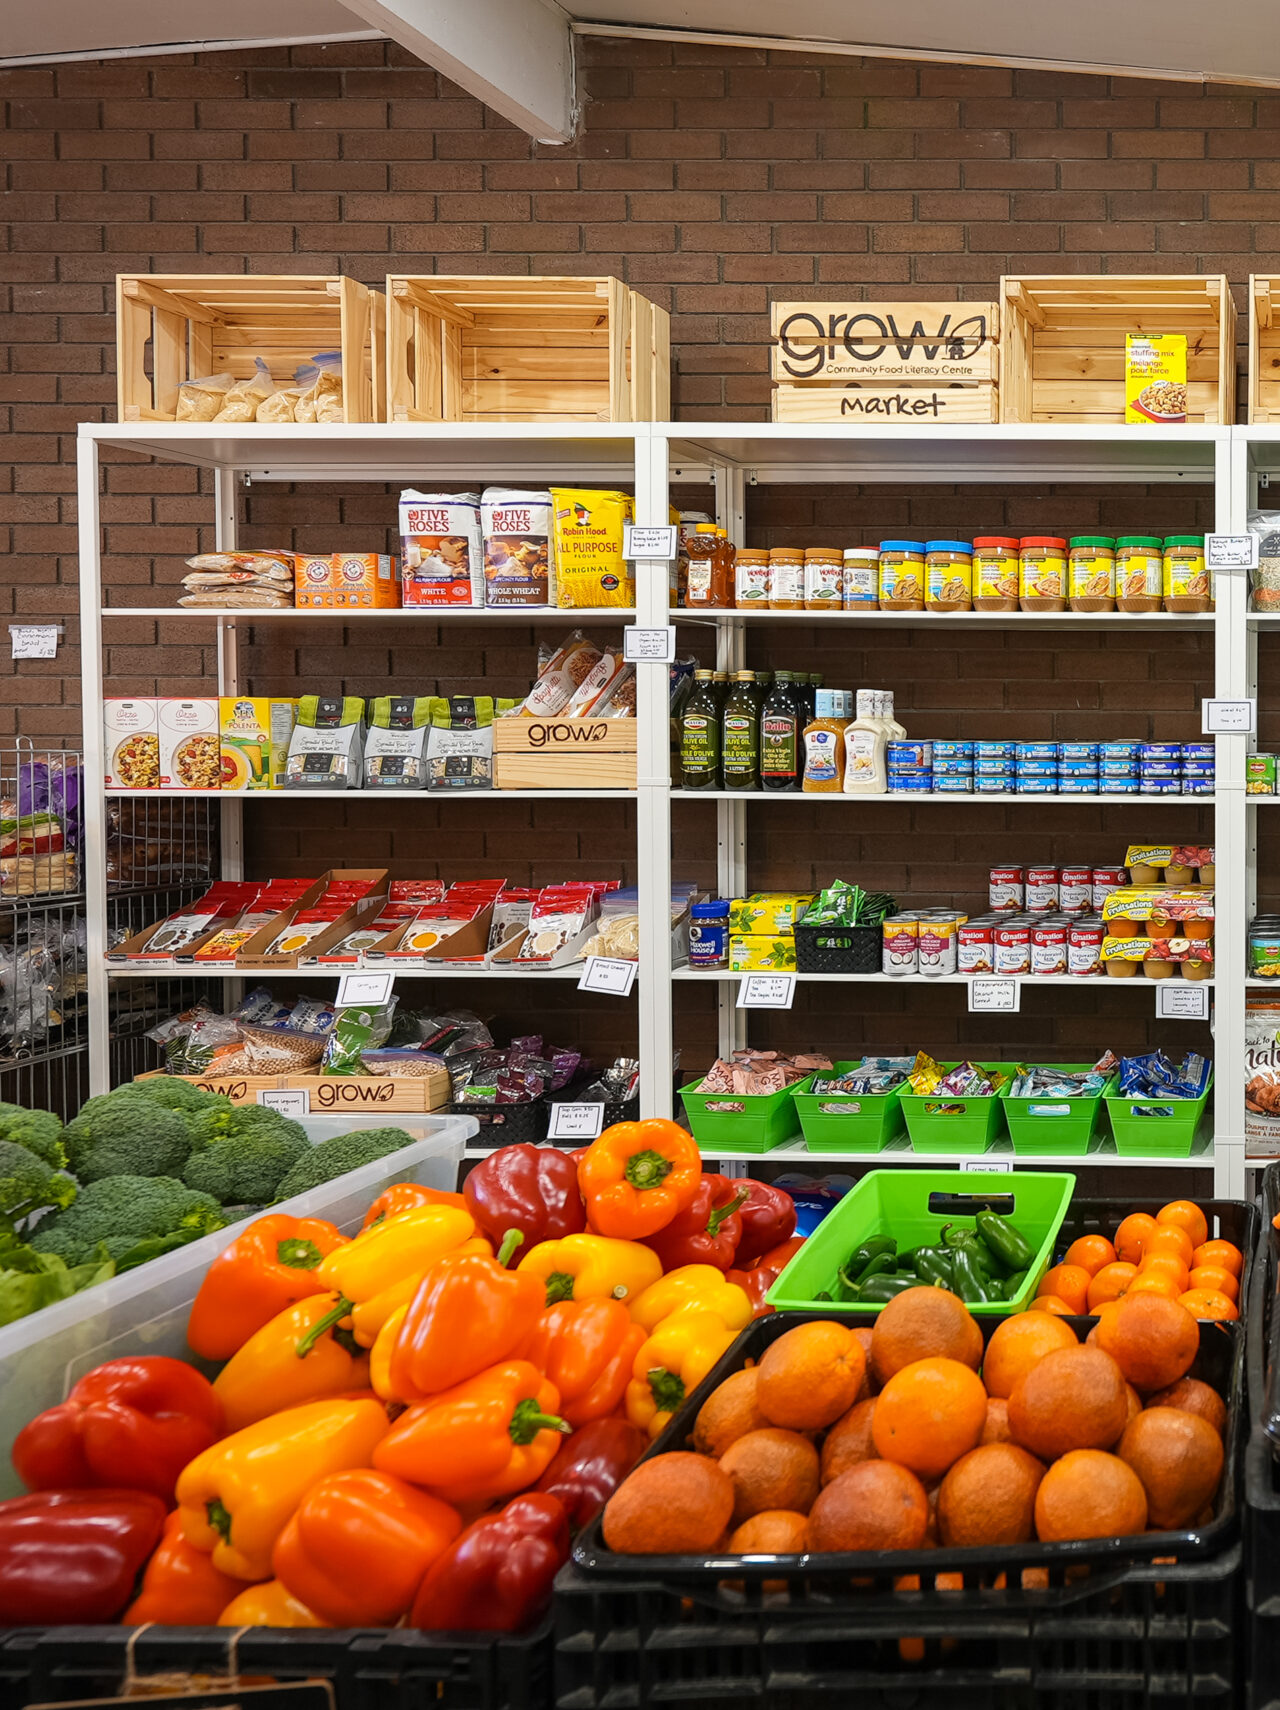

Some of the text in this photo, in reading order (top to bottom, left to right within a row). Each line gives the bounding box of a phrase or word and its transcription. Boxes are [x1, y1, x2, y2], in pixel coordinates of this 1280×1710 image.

[780, 313, 951, 378] grow
[1131, 350, 1159, 358] stuffing
[826, 364, 972, 375] Community Food Literacy Centre
[841, 393, 946, 417] market
[421, 510, 448, 520] FIVE
[504, 510, 530, 520] FIVE
[409, 522, 449, 532] ROSES
[492, 522, 530, 532] ROSES
[563, 527, 607, 535] Robin Hood
[557, 543, 618, 553] ALL PURPOSE
[565, 565, 609, 574] ORIGINAL
[579, 662, 607, 696] Spaghetti
[532, 676, 560, 704] Spaghetti
[116, 710, 137, 718] Orzo
[176, 710, 197, 718] Orzo
[528, 723, 593, 747] grow
[1130, 849, 1171, 863] Fruitsations
[1029, 873, 1054, 881] Carnation
[1062, 873, 1088, 881] Carnation
[1107, 901, 1153, 916] Fruitsations
[1000, 932, 1028, 941] Carnation
[1035, 932, 1063, 941] Carnation
[1071, 932, 1098, 941] Carnation
[1106, 941, 1151, 956] Fruitsations
[318, 1083, 381, 1105] grow
